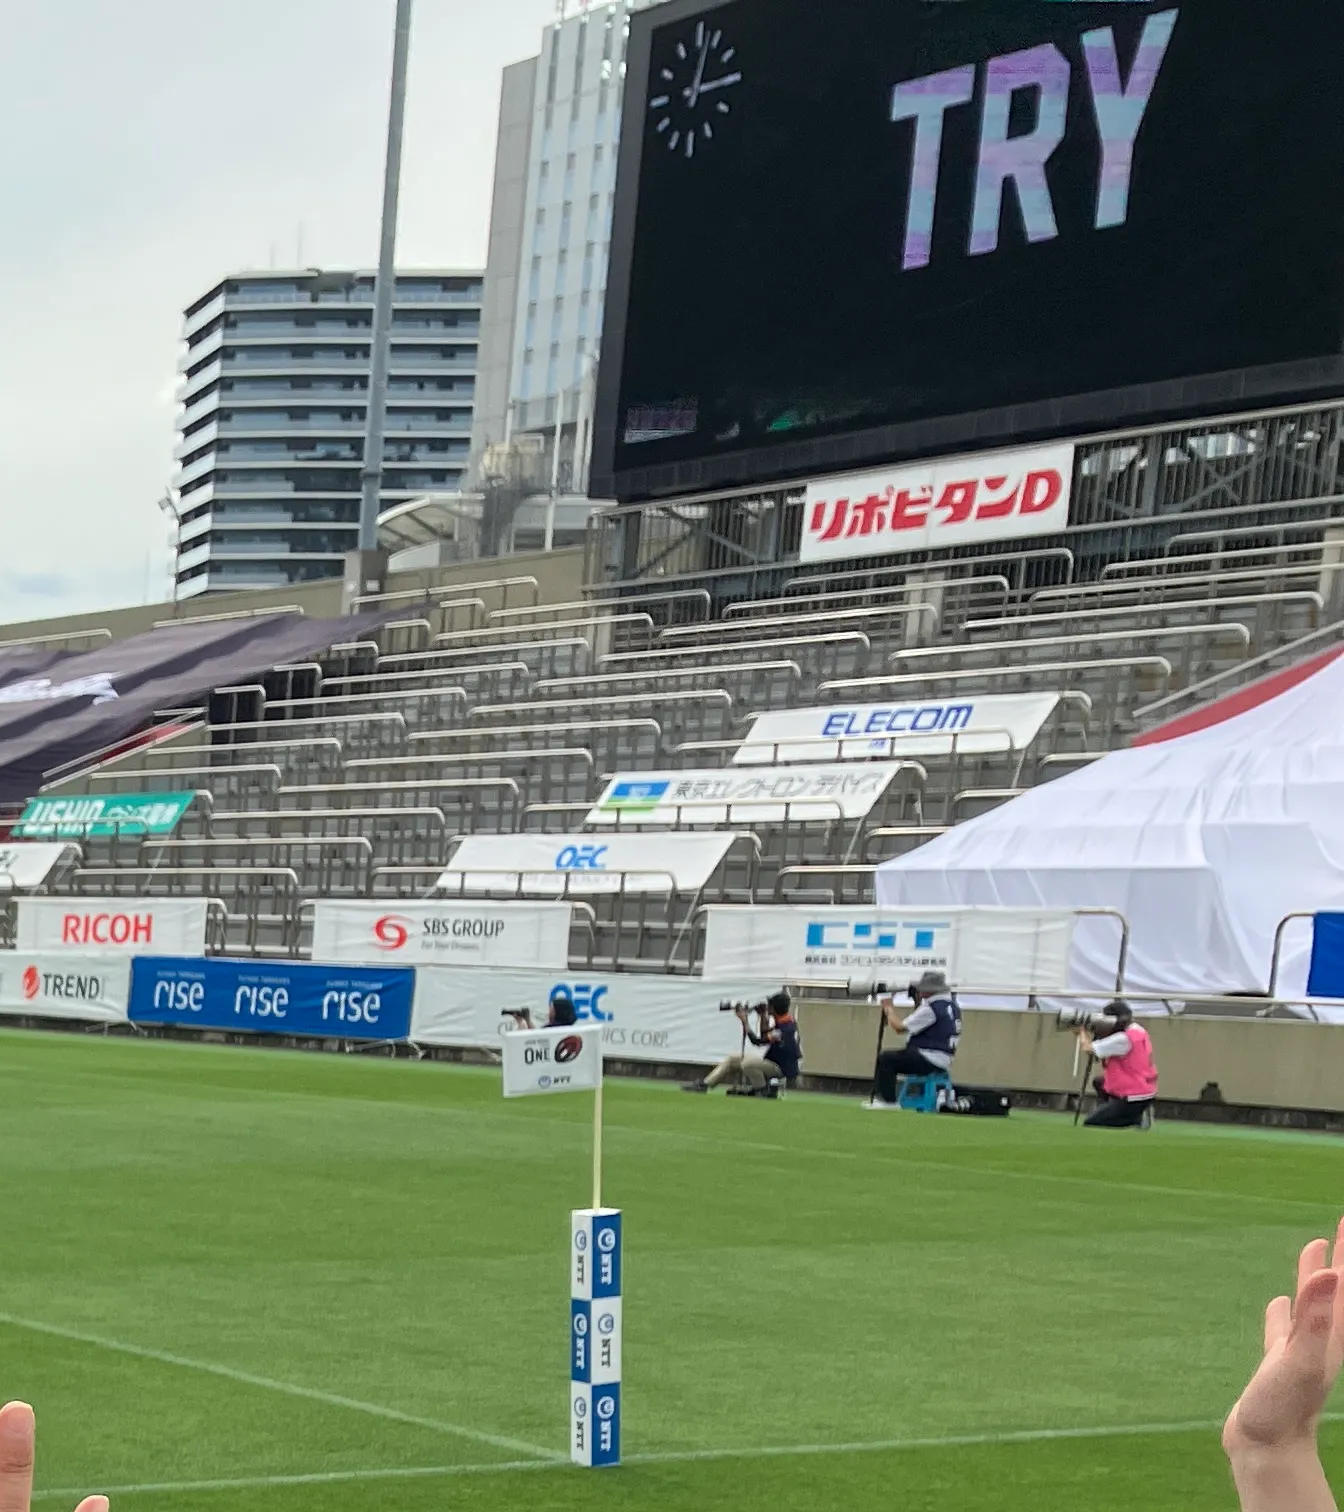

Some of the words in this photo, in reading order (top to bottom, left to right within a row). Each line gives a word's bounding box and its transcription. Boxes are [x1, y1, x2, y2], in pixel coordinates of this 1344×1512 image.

[890, 8, 1179, 270] TRY
[810, 467, 1063, 542] リポビタンD
[822, 704, 974, 736] ELECOM
[62, 912, 153, 944] RICOH
[422, 917, 449, 938] SBS
[452, 918, 505, 940] GROUP
[805, 921, 951, 949] CST
[43, 973, 100, 1000] TREND
[154, 980, 204, 1012] rise
[235, 985, 289, 1018] rise
[322, 991, 382, 1024] rise
[601, 1337, 612, 1368] NTT
